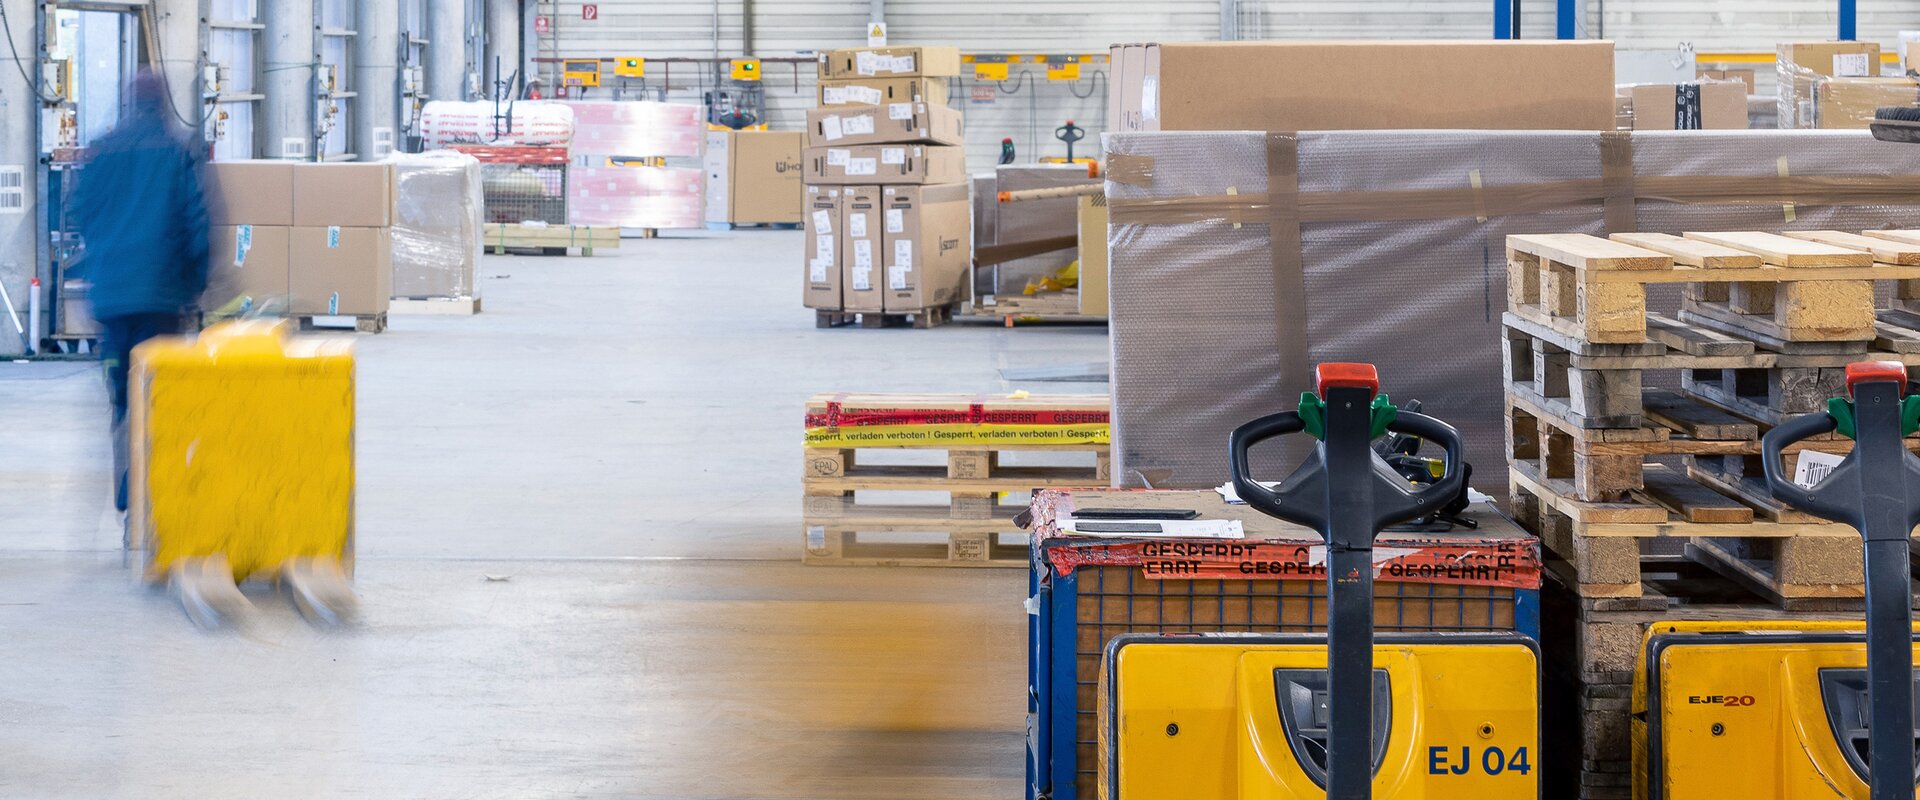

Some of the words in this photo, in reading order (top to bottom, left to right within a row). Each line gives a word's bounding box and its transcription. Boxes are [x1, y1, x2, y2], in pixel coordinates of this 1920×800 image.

[984, 413, 1038, 423] GESPERRT
[1054, 413, 1109, 424] GESPERRT
[846, 430, 884, 441] verladen
[887, 429, 926, 440] verboten
[934, 430, 975, 440] Gesperrt,
[979, 430, 1017, 438] verladen
[1020, 430, 1059, 438] verboten
[1688, 695, 1756, 707] EJE20
[1428, 745, 1470, 776] EJ
[1481, 745, 1532, 776] 04
